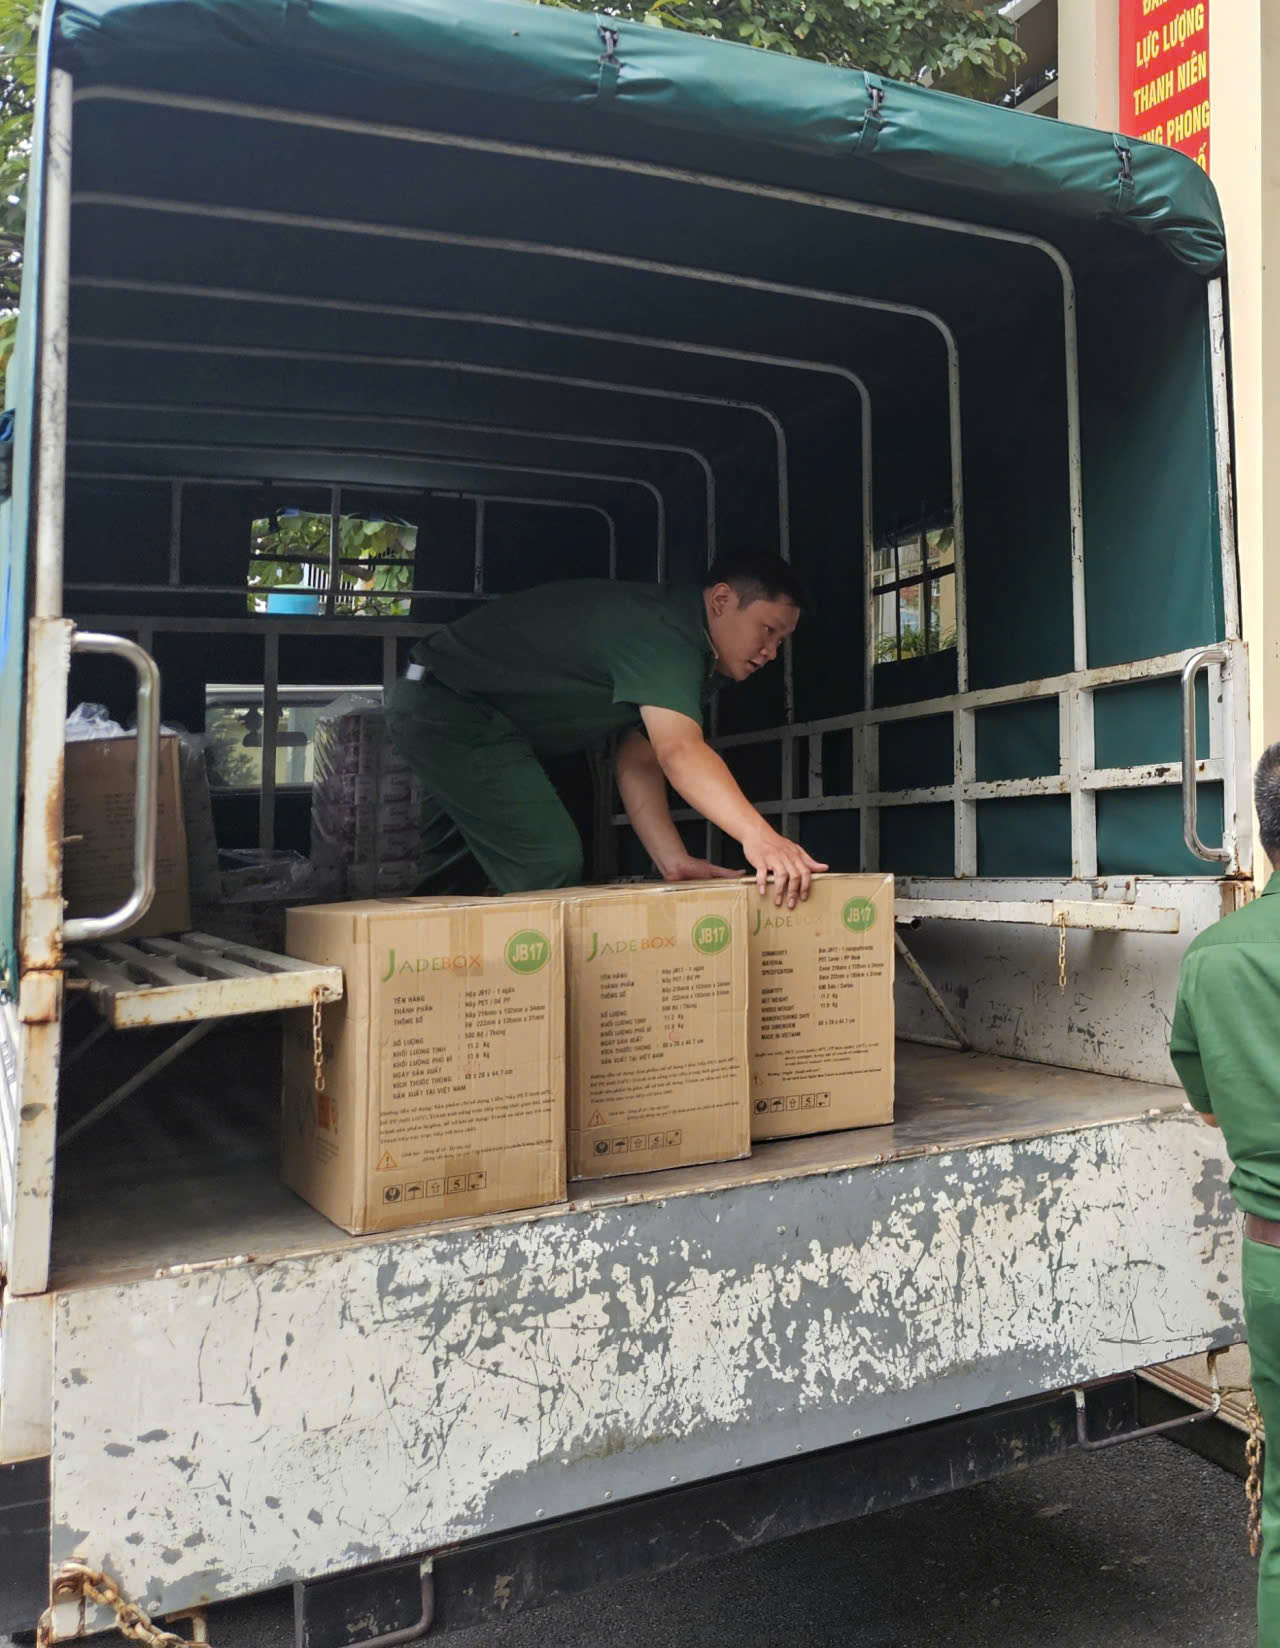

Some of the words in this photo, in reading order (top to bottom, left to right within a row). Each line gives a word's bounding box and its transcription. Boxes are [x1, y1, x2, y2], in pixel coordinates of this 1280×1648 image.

[1136, 30, 1160, 69] LỰC
[1163, 3, 1204, 52] LƯỢNG
[1133, 70, 1174, 116] THANH
[1177, 50, 1207, 93] NIÊN
[1166, 100, 1210, 147] PHONG
[848, 906, 872, 922] JB17
[586, 932, 676, 962] JADEBOX
[699, 926, 724, 944] JB17
[381, 948, 482, 983] JADEBOX
[512, 942, 544, 962] JB17
